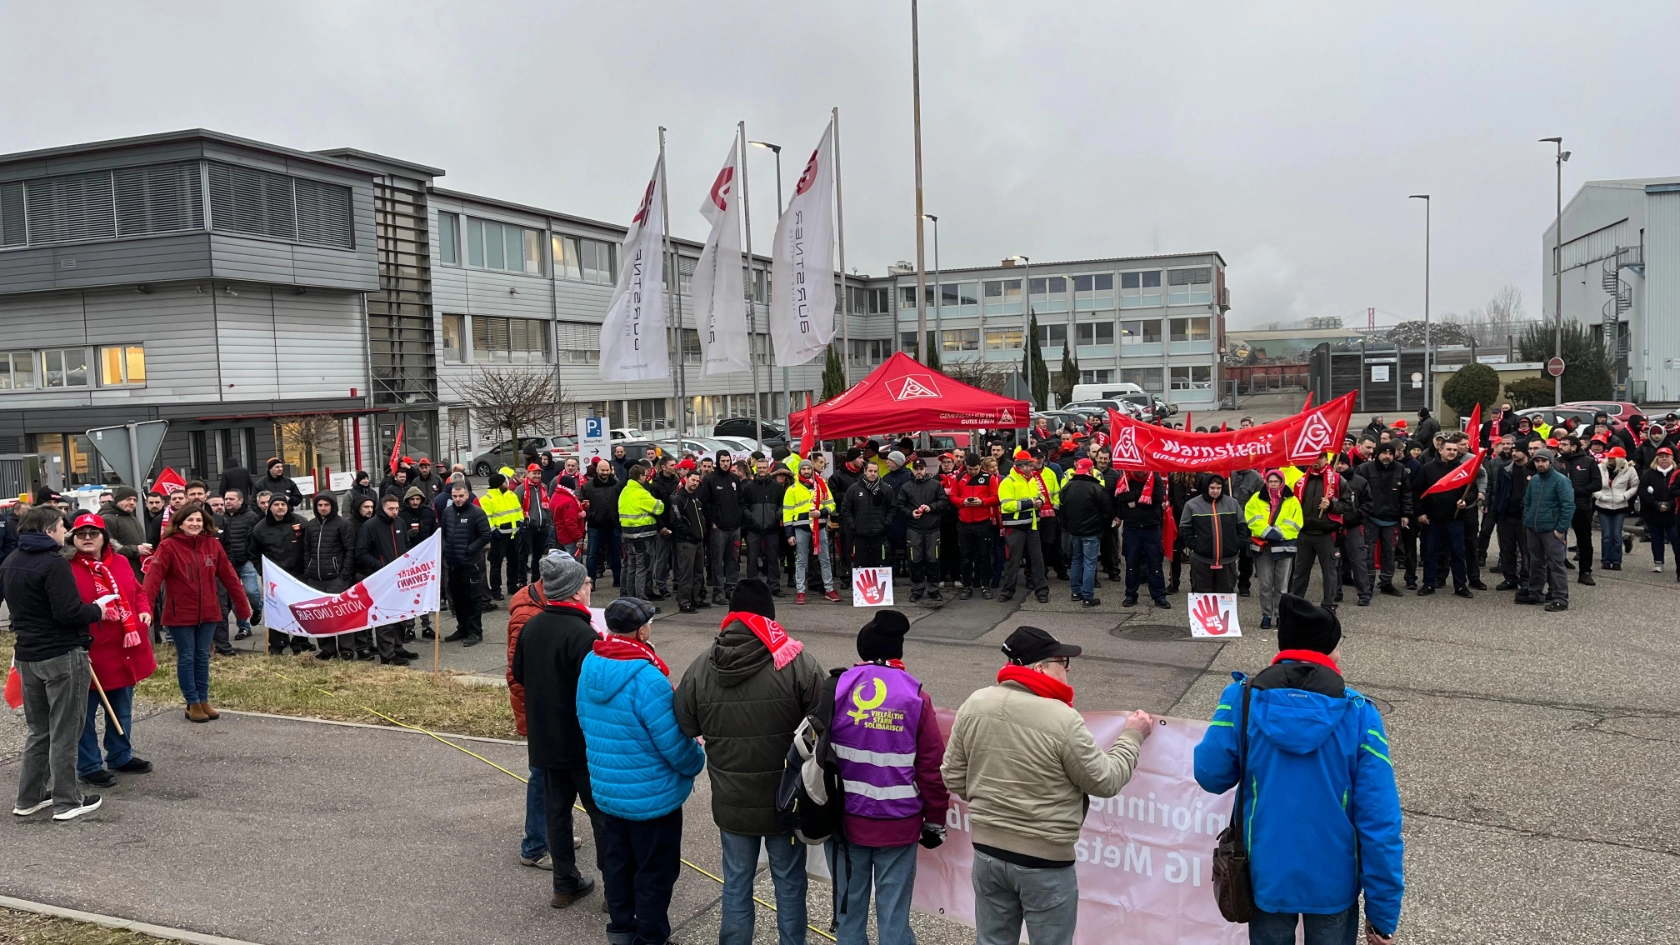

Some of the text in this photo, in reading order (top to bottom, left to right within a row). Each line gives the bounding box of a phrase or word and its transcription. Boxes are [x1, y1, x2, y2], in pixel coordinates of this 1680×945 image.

[587, 420, 597, 433] P
[872, 590, 880, 601] 5
[1214, 620, 1224, 631] 5
[871, 710, 904, 720] VIELFÄLTIG
[864, 721, 904, 732] SOLIDARISCH
